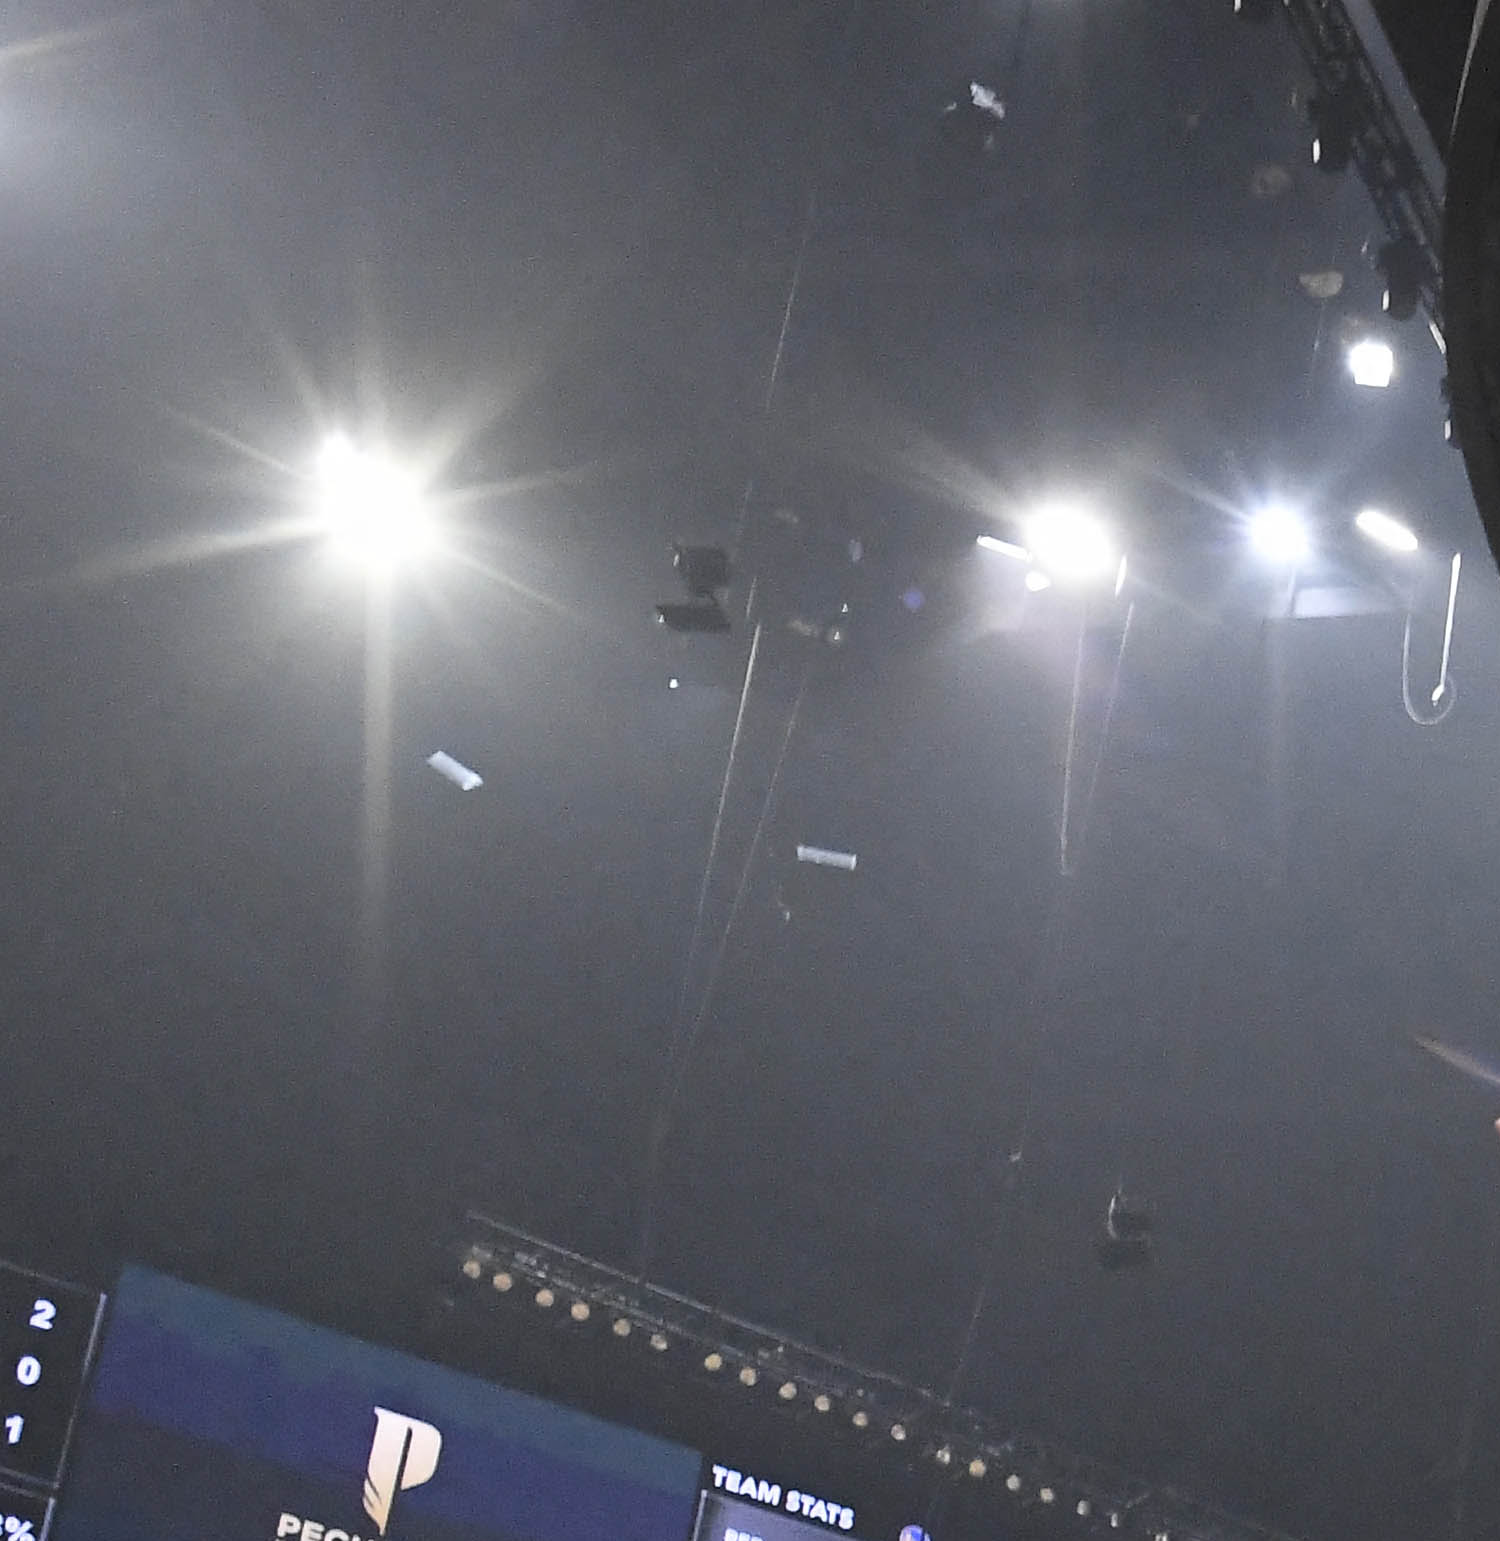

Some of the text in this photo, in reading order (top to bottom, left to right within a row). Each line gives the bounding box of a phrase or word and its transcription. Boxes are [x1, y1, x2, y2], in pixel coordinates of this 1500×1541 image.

[29, 1299, 57, 1331] 2
[15, 1355, 42, 1386] 0
[3, 1413, 25, 1445] 1
[711, 1464, 855, 1531] TEAM STATS
